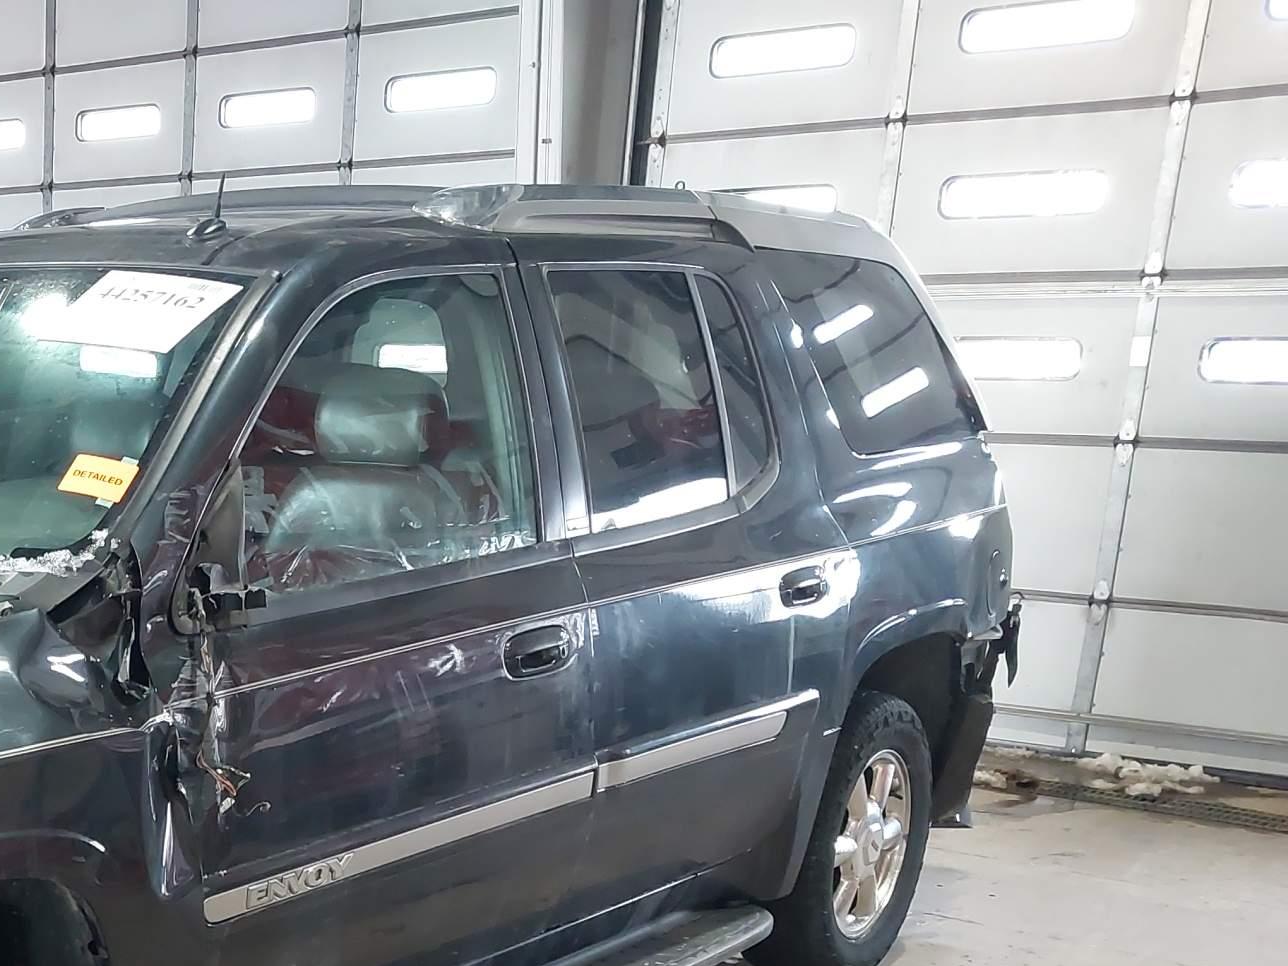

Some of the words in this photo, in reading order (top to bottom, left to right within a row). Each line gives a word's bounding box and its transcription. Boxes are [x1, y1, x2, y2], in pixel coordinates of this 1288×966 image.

[100, 287, 205, 309] 44257162
[72, 469, 124, 486] DETAILED
[245, 853, 354, 909] ENVOY
